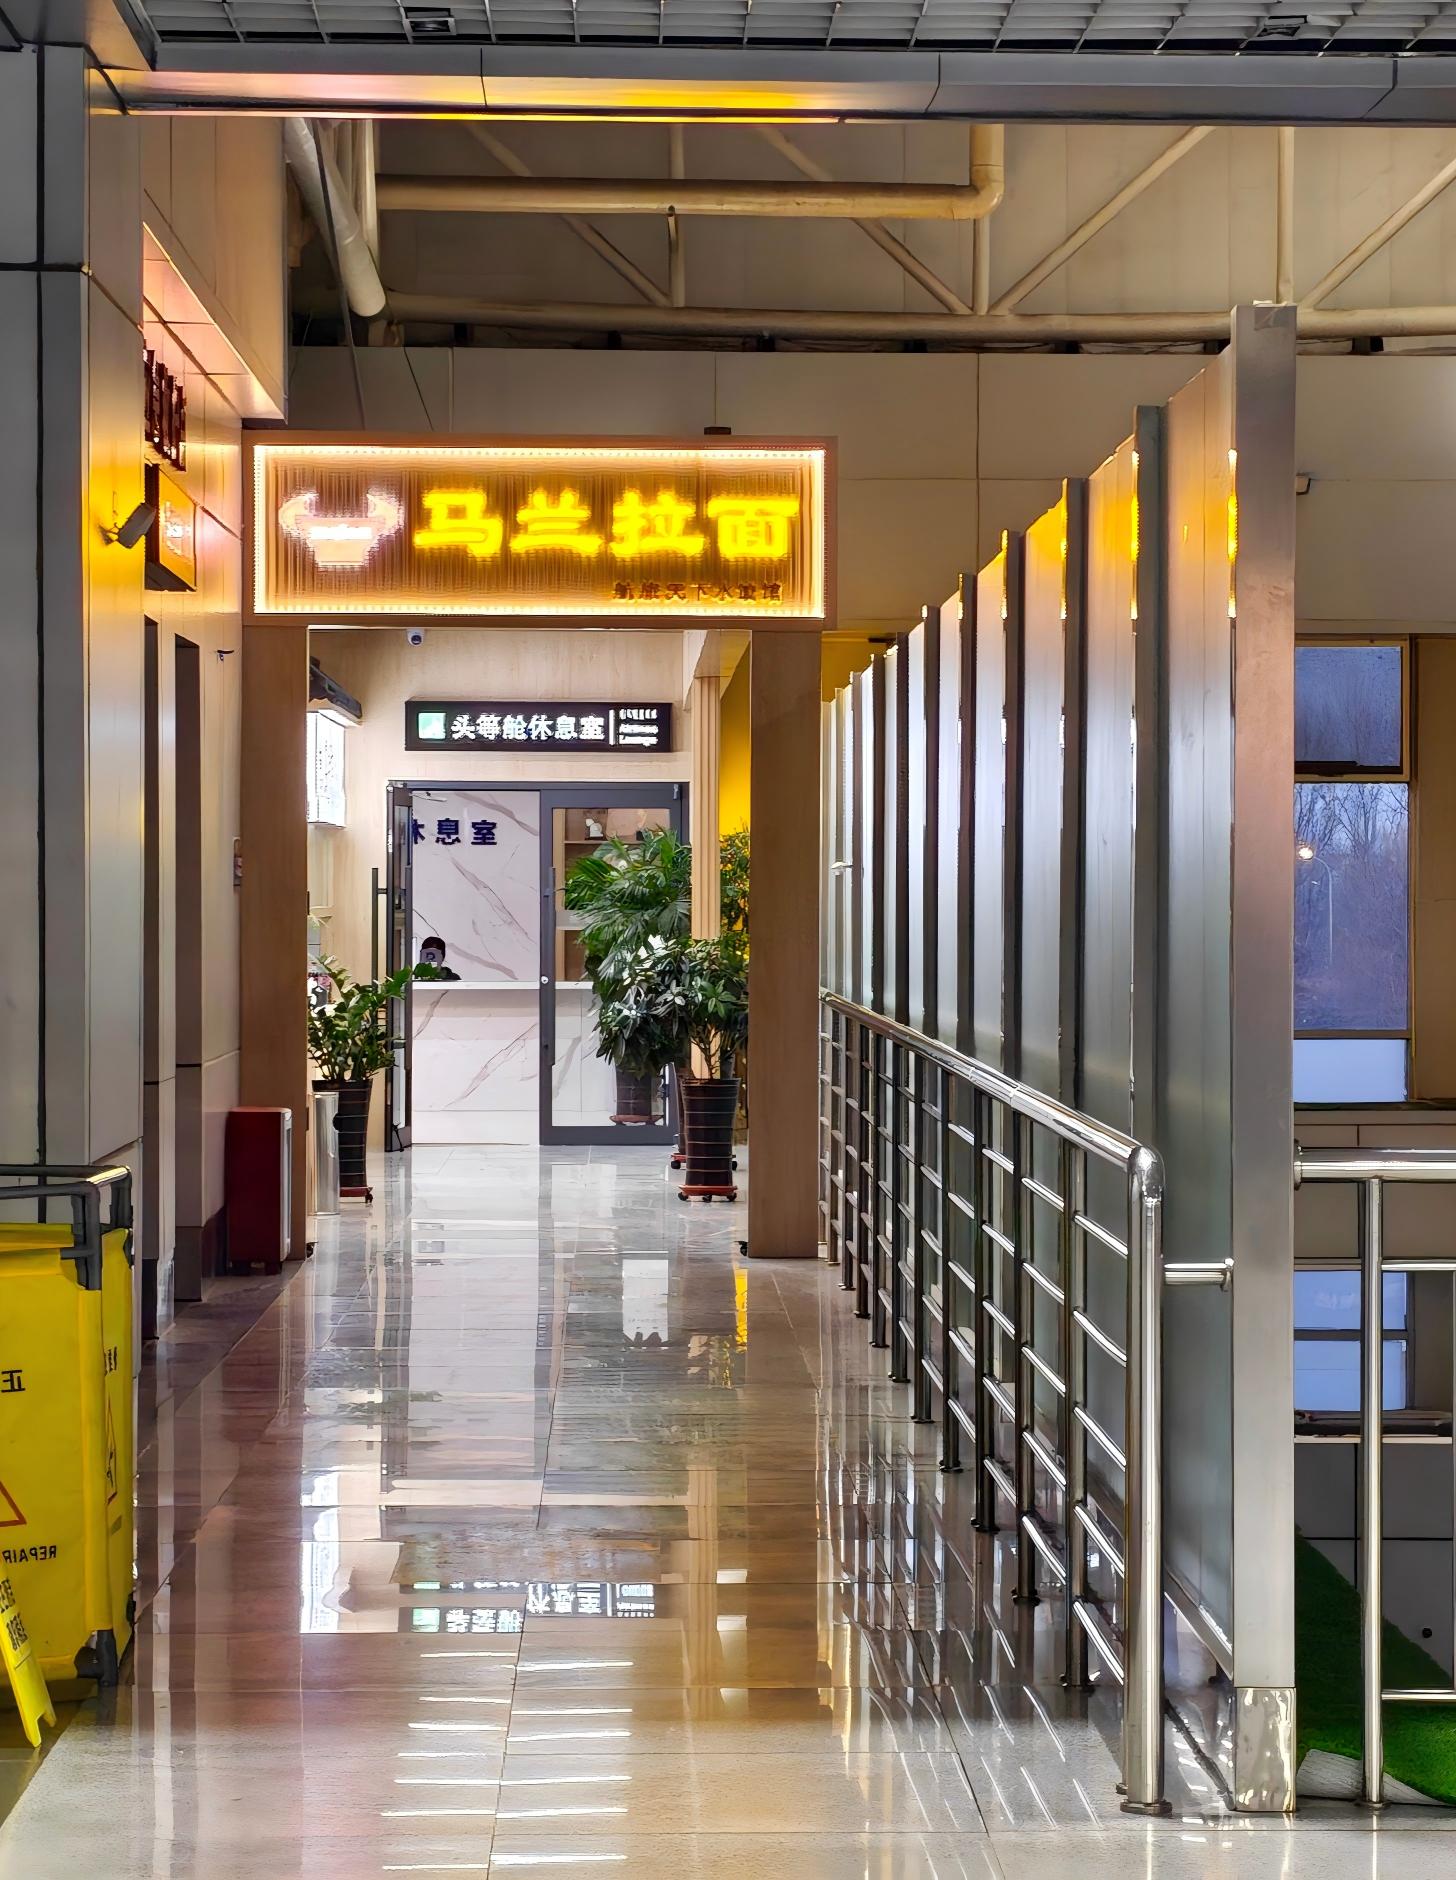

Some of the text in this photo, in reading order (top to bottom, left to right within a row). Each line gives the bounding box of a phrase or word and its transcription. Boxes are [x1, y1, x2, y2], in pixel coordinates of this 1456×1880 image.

[412, 487, 803, 560] 马兰拉面
[451, 713, 606, 741] 头等舱休息室
